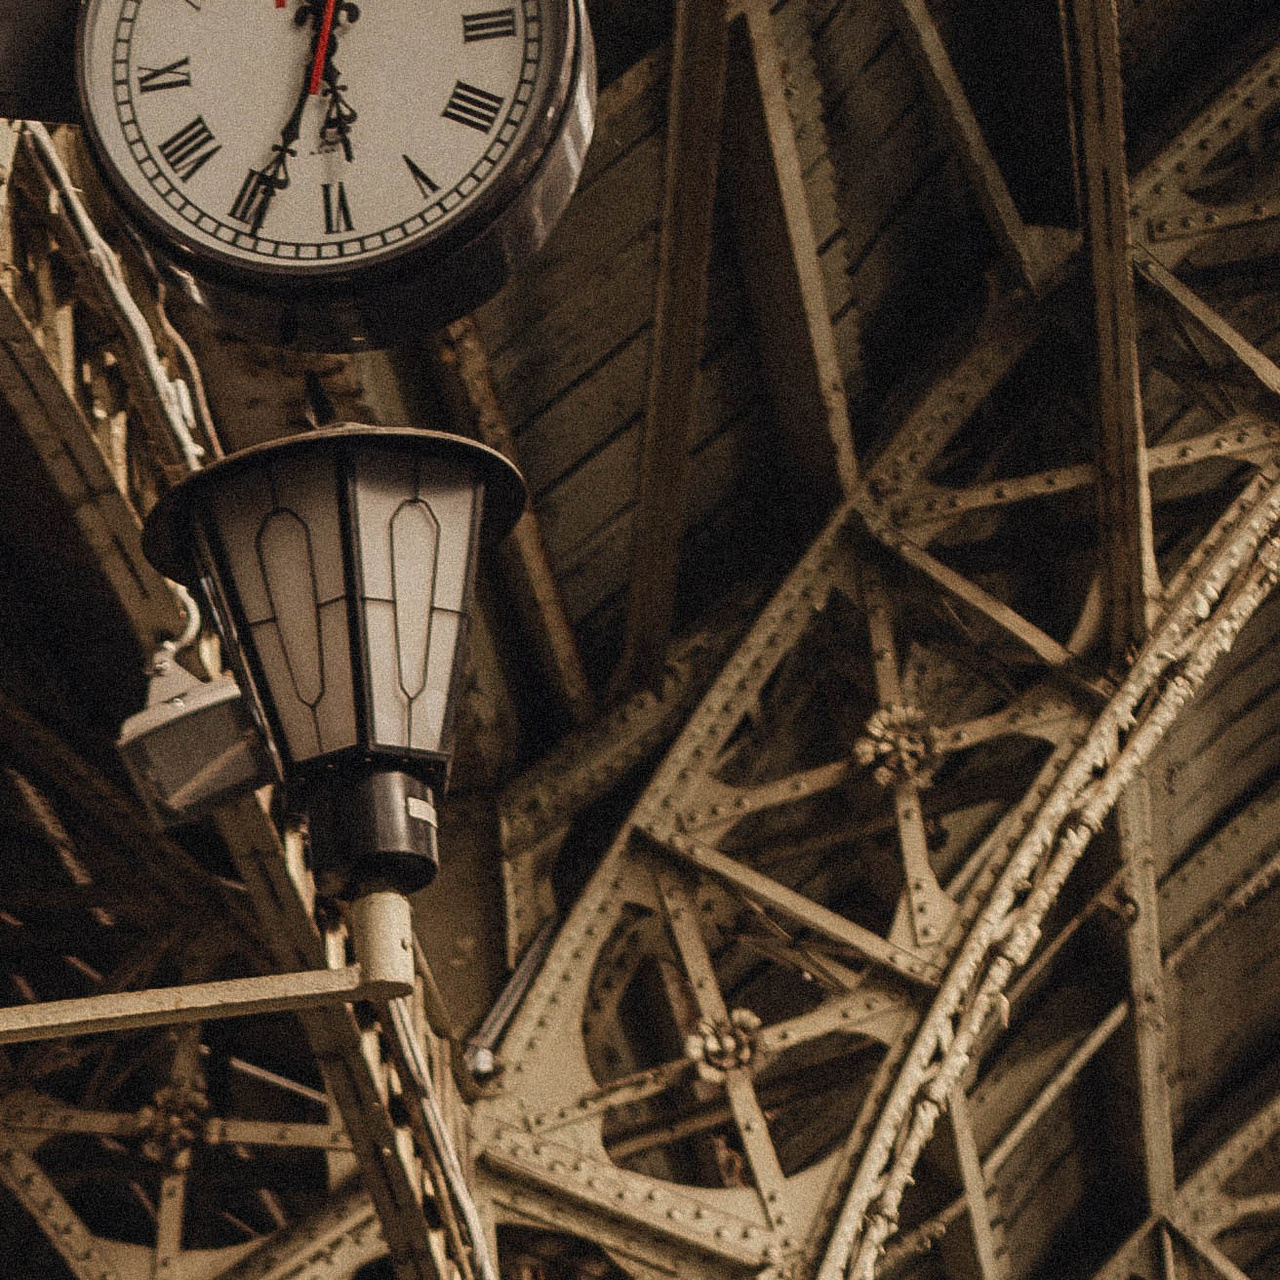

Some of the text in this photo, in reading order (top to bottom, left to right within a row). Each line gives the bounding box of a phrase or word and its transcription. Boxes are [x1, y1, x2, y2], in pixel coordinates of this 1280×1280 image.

[137, 56, 191, 93] IX
[158, 114, 222, 182] VIII
[321, 181, 355, 235] VI
